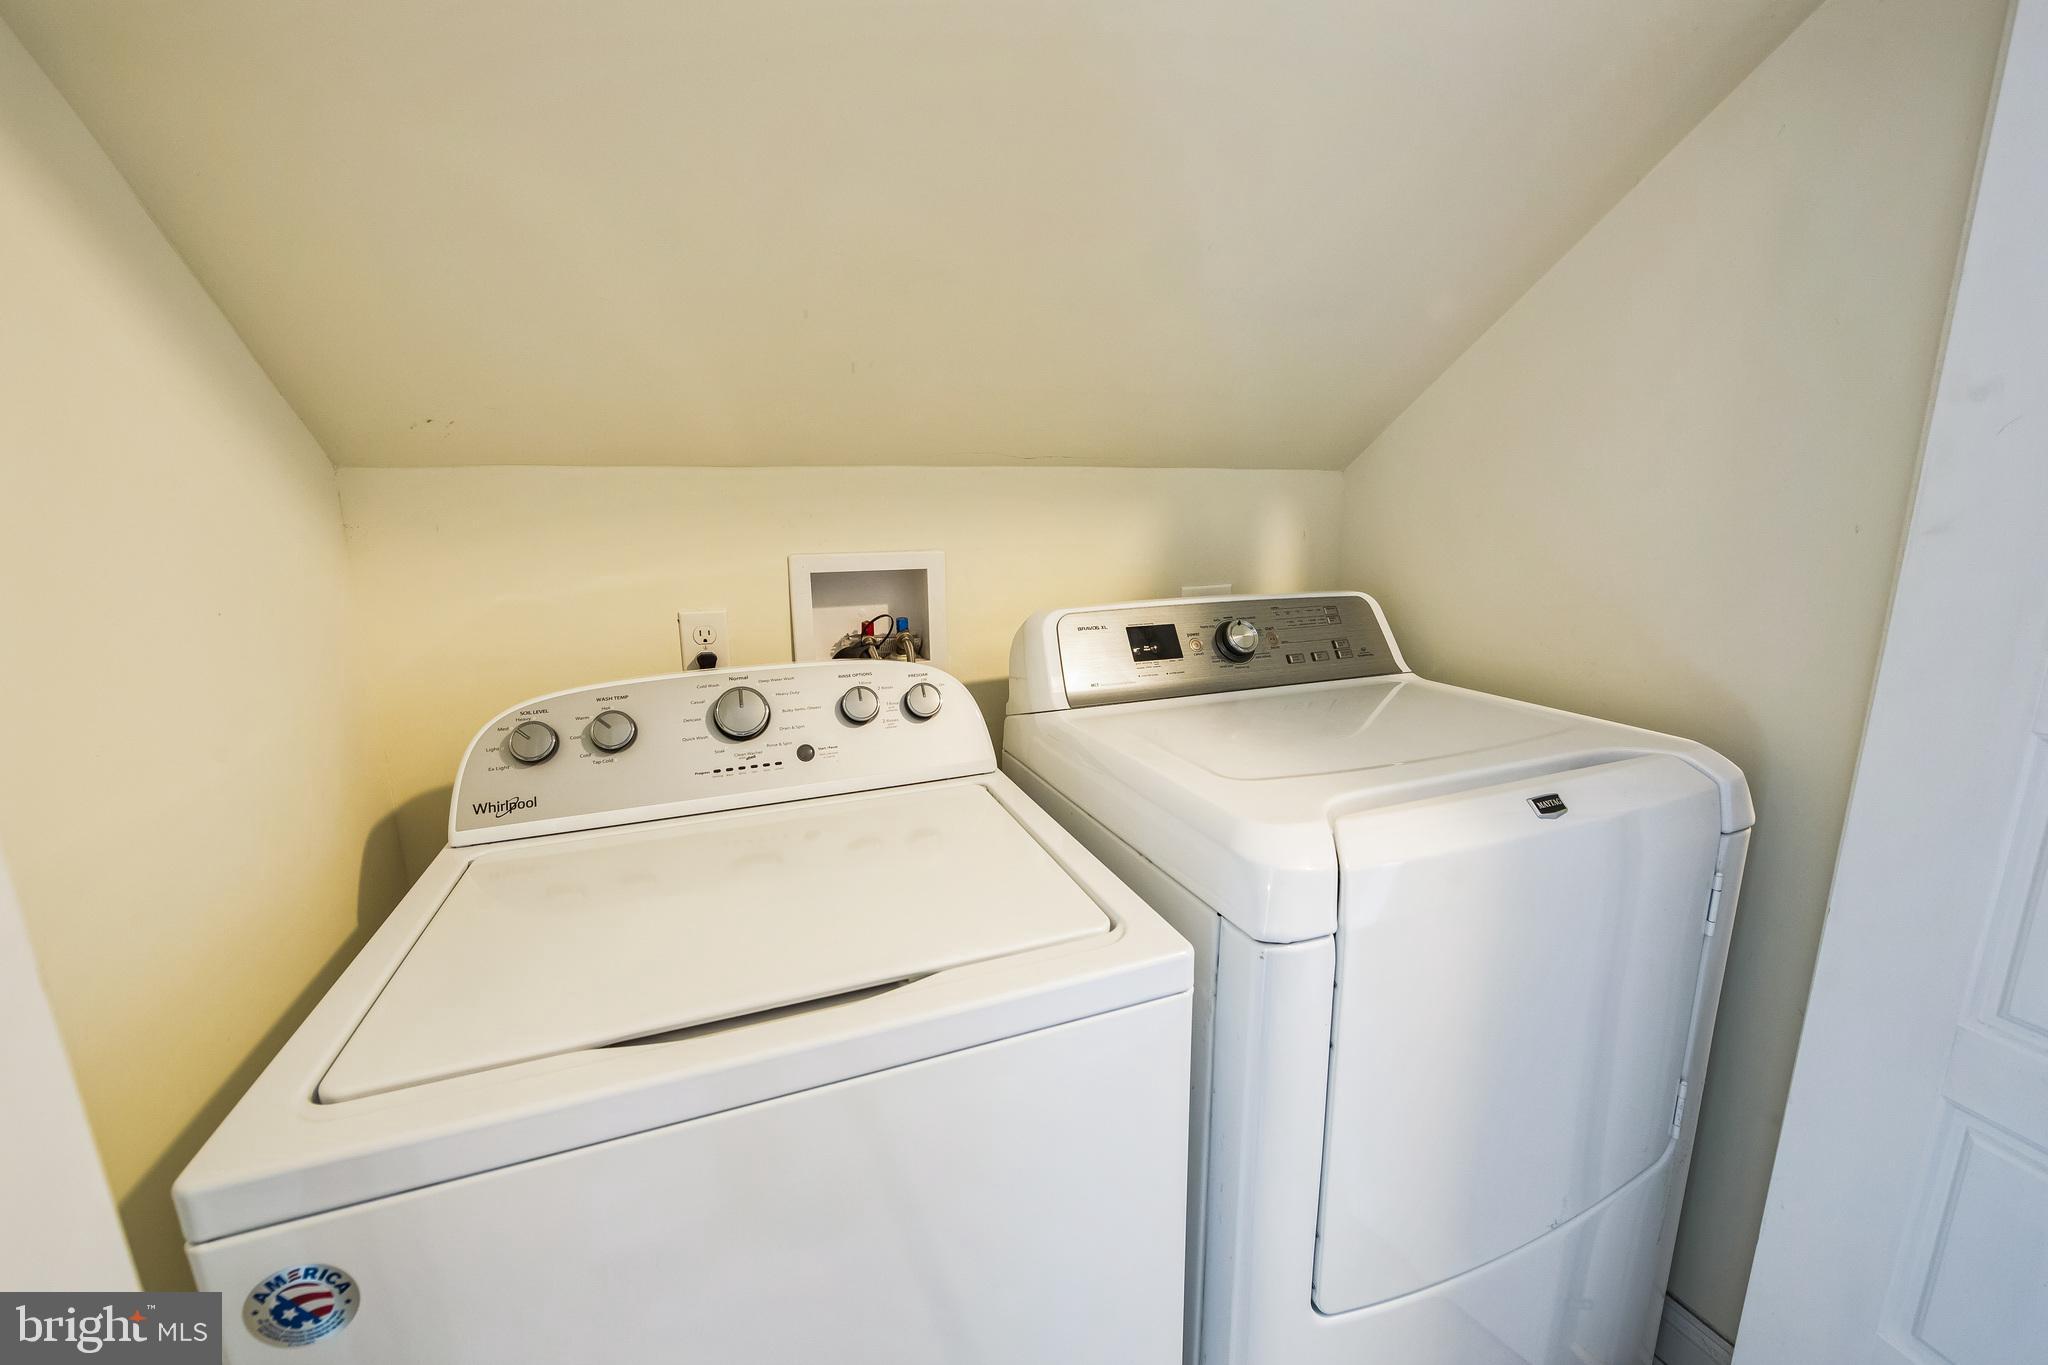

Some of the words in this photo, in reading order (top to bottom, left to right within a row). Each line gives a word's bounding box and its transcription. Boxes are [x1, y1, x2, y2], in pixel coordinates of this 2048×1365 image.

[596, 695, 614, 703] WASH
[472, 796, 537, 818] Whirlpool
[1537, 797, 1562, 809] MAYTAG
[253, 1267, 352, 1304] AMERICA
